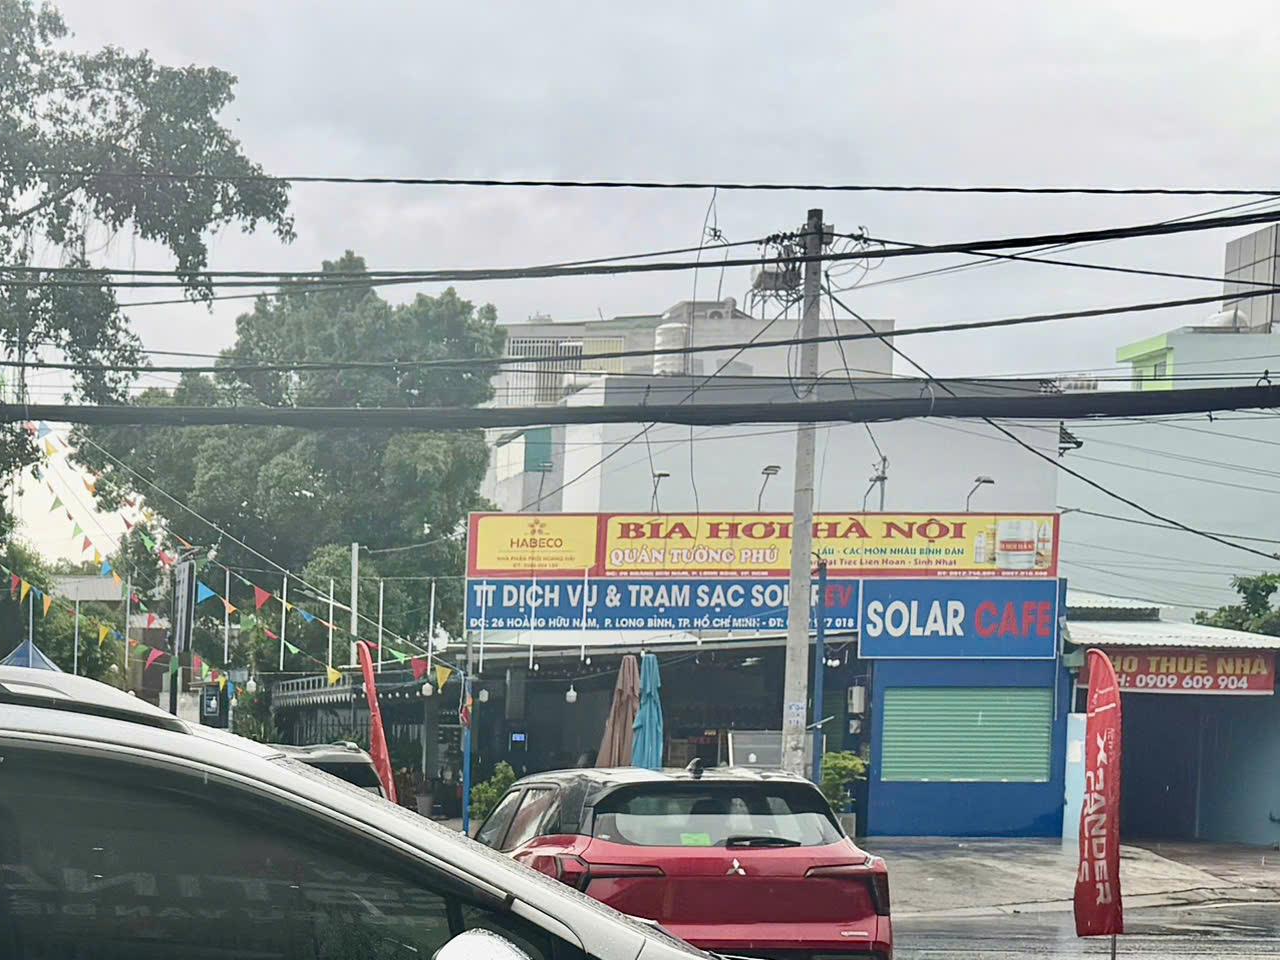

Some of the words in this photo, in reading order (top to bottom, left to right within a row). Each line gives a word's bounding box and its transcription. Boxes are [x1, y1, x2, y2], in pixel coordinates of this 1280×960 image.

[617, 521, 696, 540] BIA
[706, 521, 793, 540] HƠI
[811, 517, 873, 540] HÀ
[883, 519, 967, 543] NỘI
[510, 538, 563, 549] HABECO
[611, 546, 664, 564] QUÁN
[670, 545, 735, 563] TƯỜNG
[741, 546, 778, 563] PHÚ
[882, 558, 905, 566] Hoan
[914, 558, 933, 566] Sinh
[473, 584, 496, 607] TT
[503, 584, 560, 612] DỊCH
[567, 584, 598, 612] VỤ
[605, 584, 621, 608] &
[628, 584, 690, 612] TRẠM
[696, 584, 745, 612] SẠC
[491, 617, 504, 628] 26
[507, 614, 546, 628] HOÀNG
[548, 615, 570, 628] HỮU
[572, 617, 599, 630] NAM,
[615, 617, 645, 628] LONG
[647, 614, 675, 630] BÌNH,
[677, 617, 691, 628] TP.
[694, 614, 709, 628] HỒ
[712, 615, 732, 628] CHÍ
[835, 617, 855, 628] 018
[866, 600, 965, 637] SOLAR
[975, 601, 1052, 638] CAFE
[1111, 655, 1138, 674] HO
[1147, 653, 1208, 675] THUÊ
[1216, 655, 1268, 675] NHÀ
[1116, 675, 1130, 687] H:
[1135, 675, 1178, 688] 0909
[1182, 676, 1214, 688] 609
[1217, 676, 1248, 689] 904
